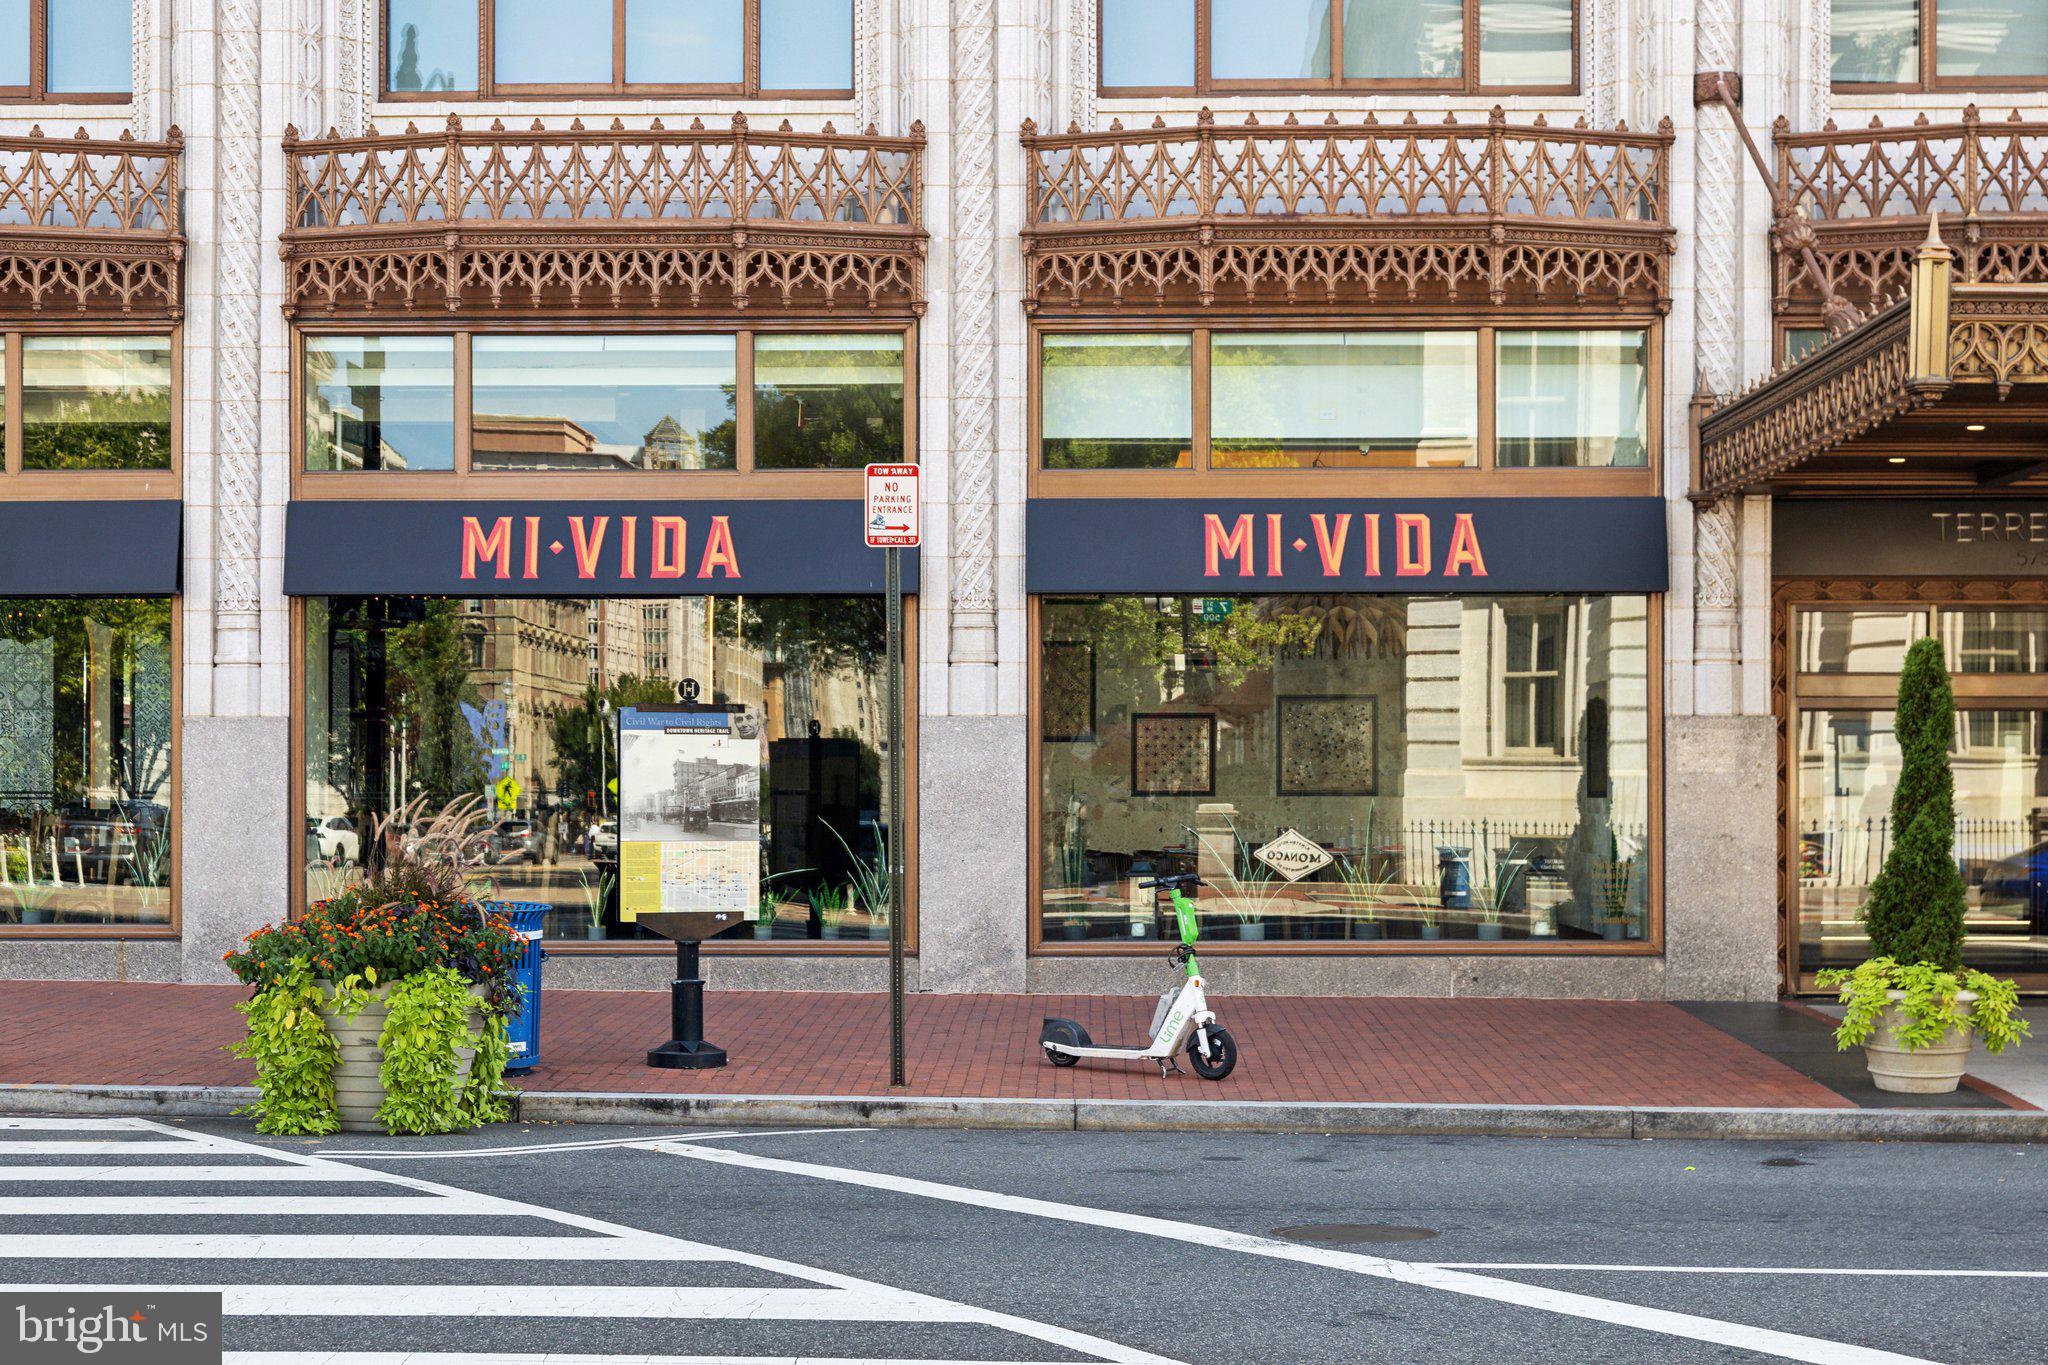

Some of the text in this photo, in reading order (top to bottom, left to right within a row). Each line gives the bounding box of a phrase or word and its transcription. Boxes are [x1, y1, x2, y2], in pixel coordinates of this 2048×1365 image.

[884, 482, 899, 492] NO
[873, 495, 912, 503] PARKING
[872, 506, 913, 514] ENTRANCE
[1931, 512, 2048, 543] TERRE
[461, 516, 740, 579] MI VIDA
[1204, 514, 1487, 576] MI VIDA
[625, 717, 722, 728] Civil War to Civil Rights
